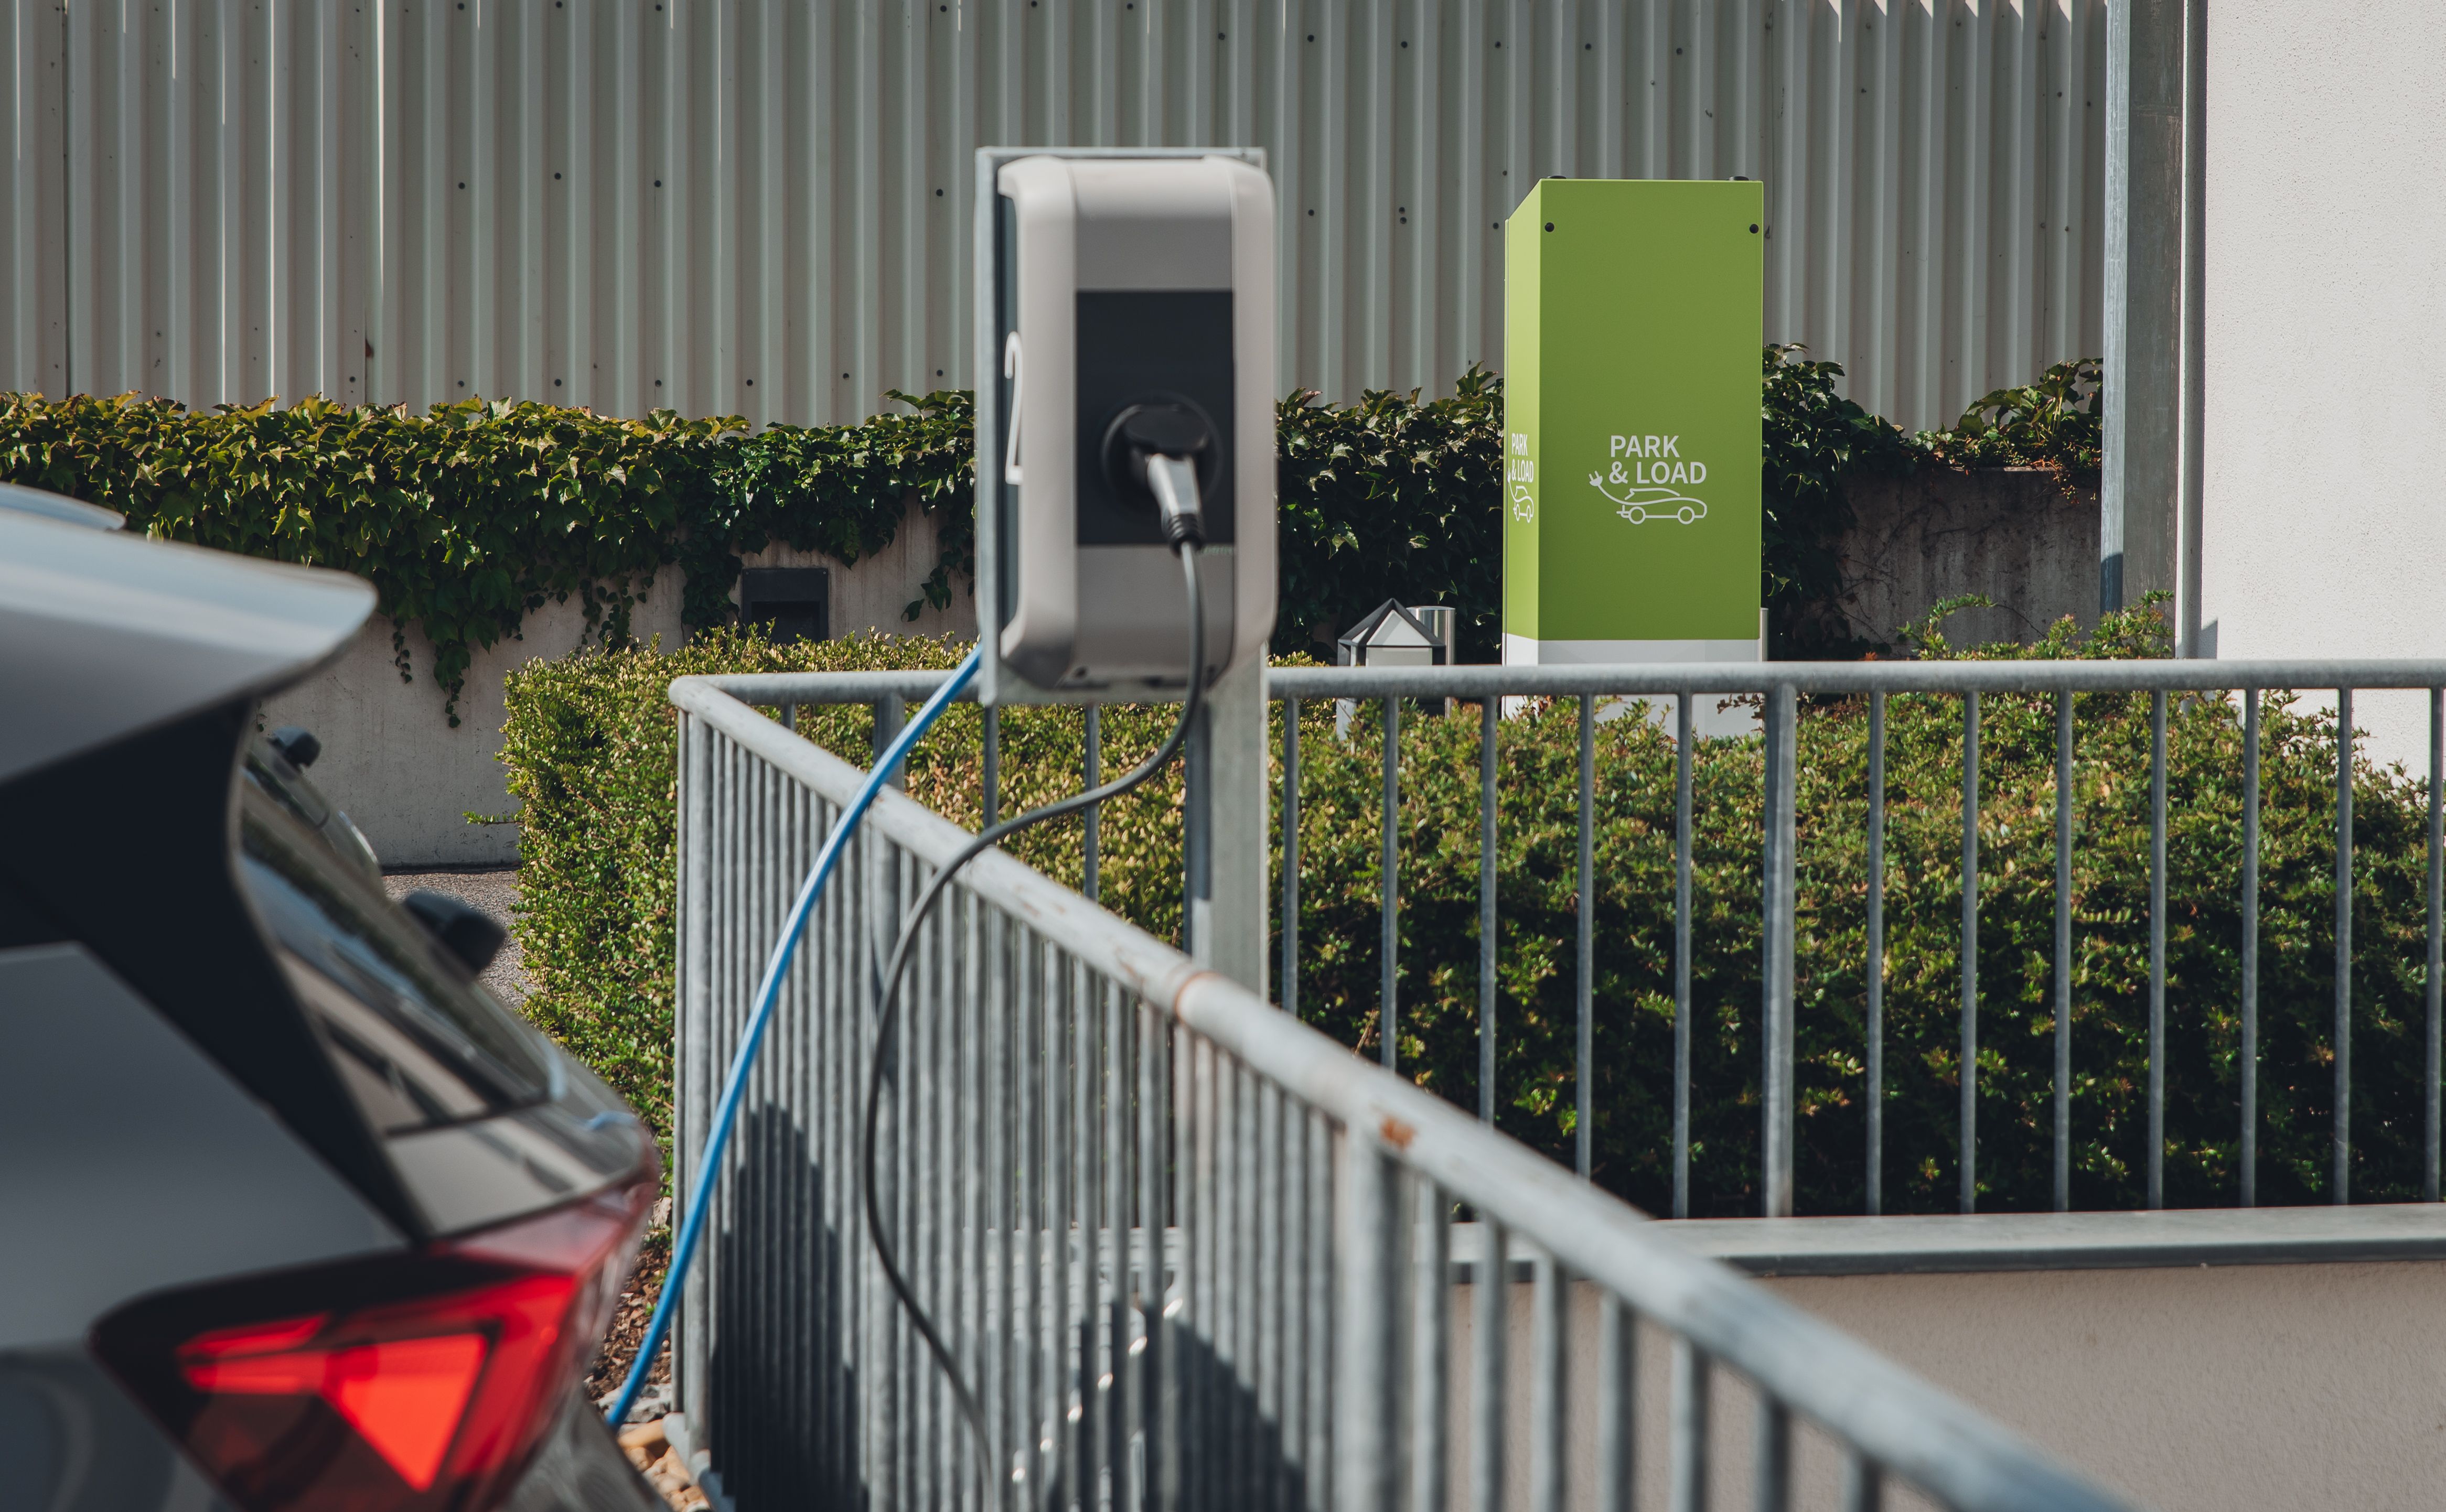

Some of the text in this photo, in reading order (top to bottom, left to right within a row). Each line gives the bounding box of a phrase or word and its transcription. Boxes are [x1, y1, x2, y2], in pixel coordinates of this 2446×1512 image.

[1511, 433, 1528, 456] PARK
[1611, 435, 1680, 458] PARK
[1511, 458, 1534, 483] & LOAD
[1609, 461, 1707, 484] & LOAD
